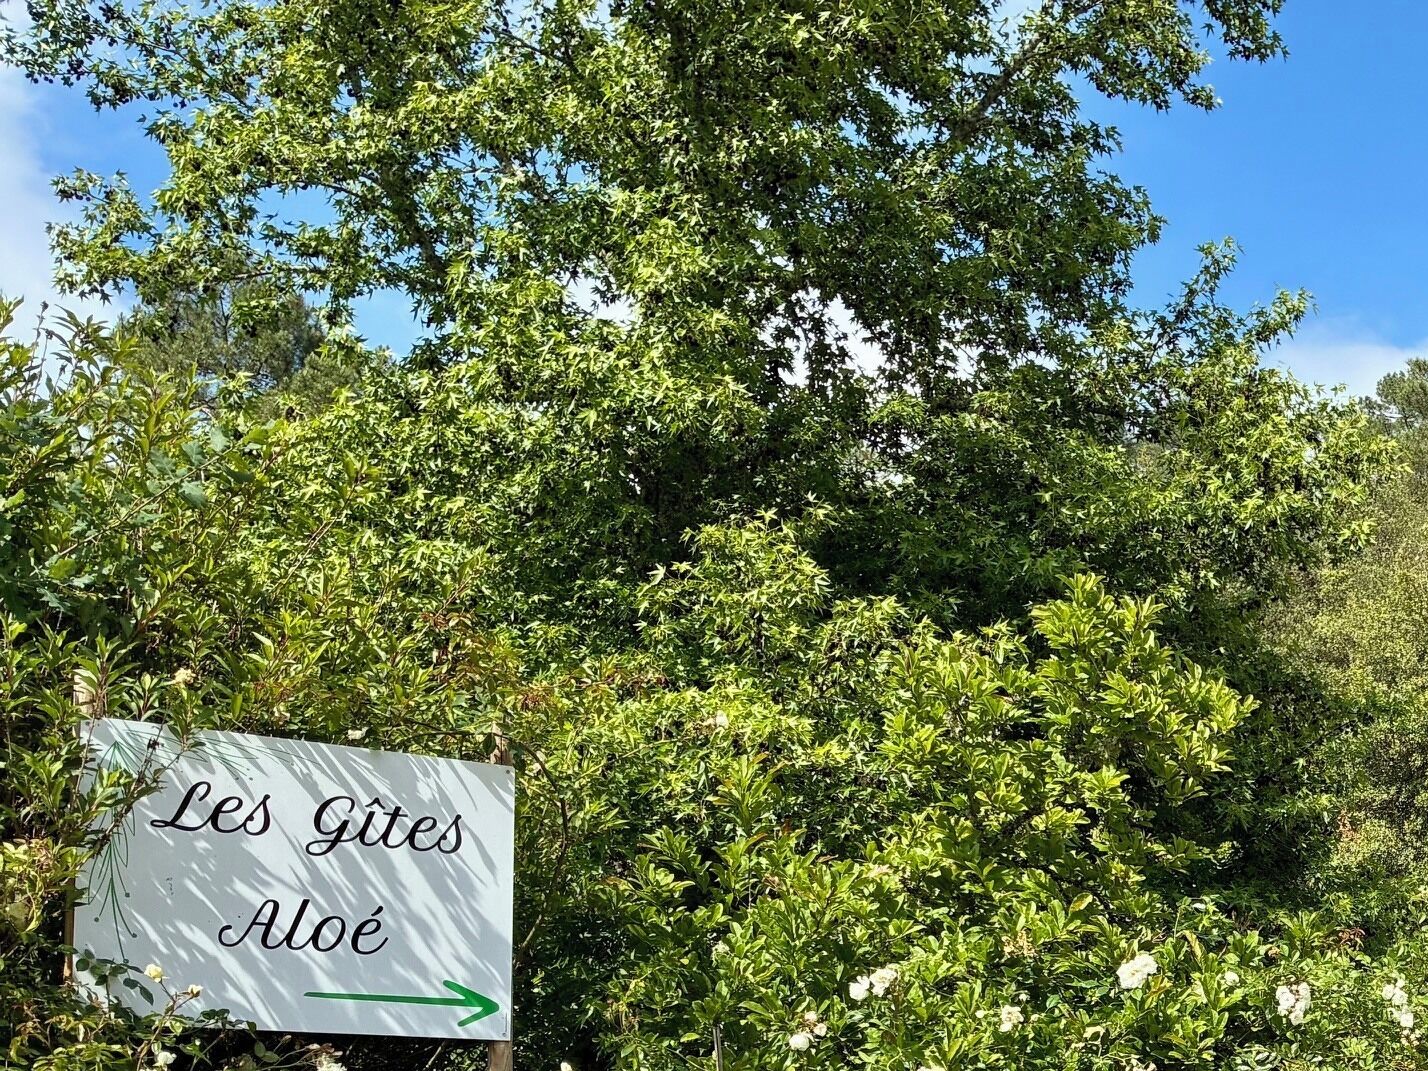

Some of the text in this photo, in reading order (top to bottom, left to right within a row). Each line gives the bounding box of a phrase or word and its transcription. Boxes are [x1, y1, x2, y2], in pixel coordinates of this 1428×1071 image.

[150, 782, 462, 856] Les Gîtes
[218, 900, 389, 955] Aloé
